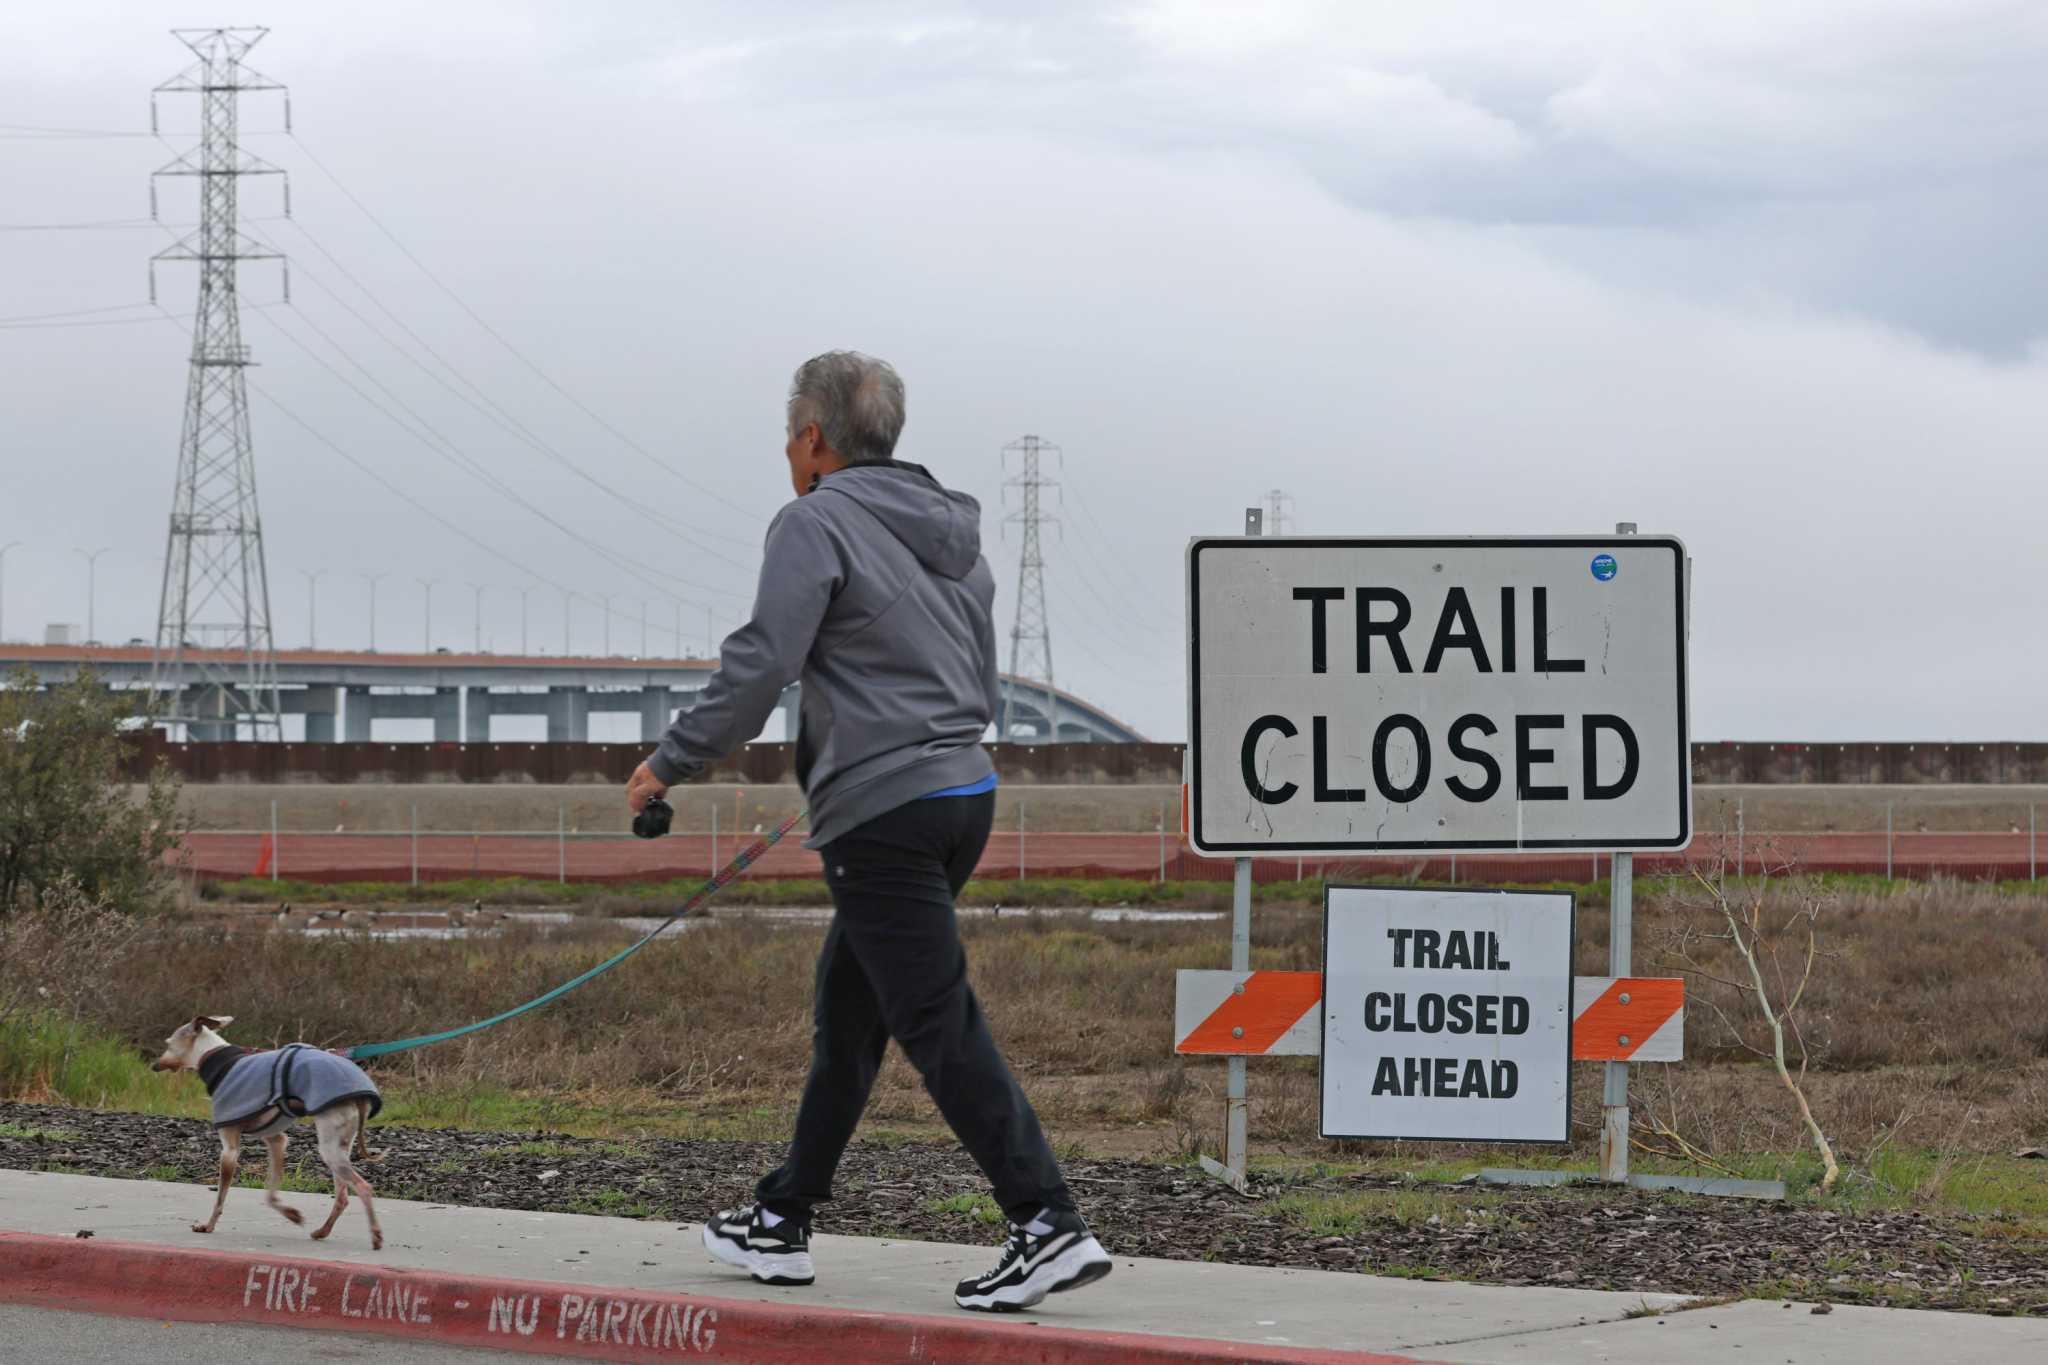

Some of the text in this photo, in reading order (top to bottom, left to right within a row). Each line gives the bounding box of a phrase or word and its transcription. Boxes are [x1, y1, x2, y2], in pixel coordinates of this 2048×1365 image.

[1292, 586, 1586, 674] TRAIL
[1240, 713, 1640, 804] CLOSED
[1386, 928, 1511, 971] TRAIL
[1363, 991, 1531, 1036] CLOSED
[1371, 1056, 1519, 1100] AHEAD
[243, 1265, 322, 1313] FIRE
[340, 1272, 432, 1325] LANE
[556, 1293, 719, 1353] PARKING
